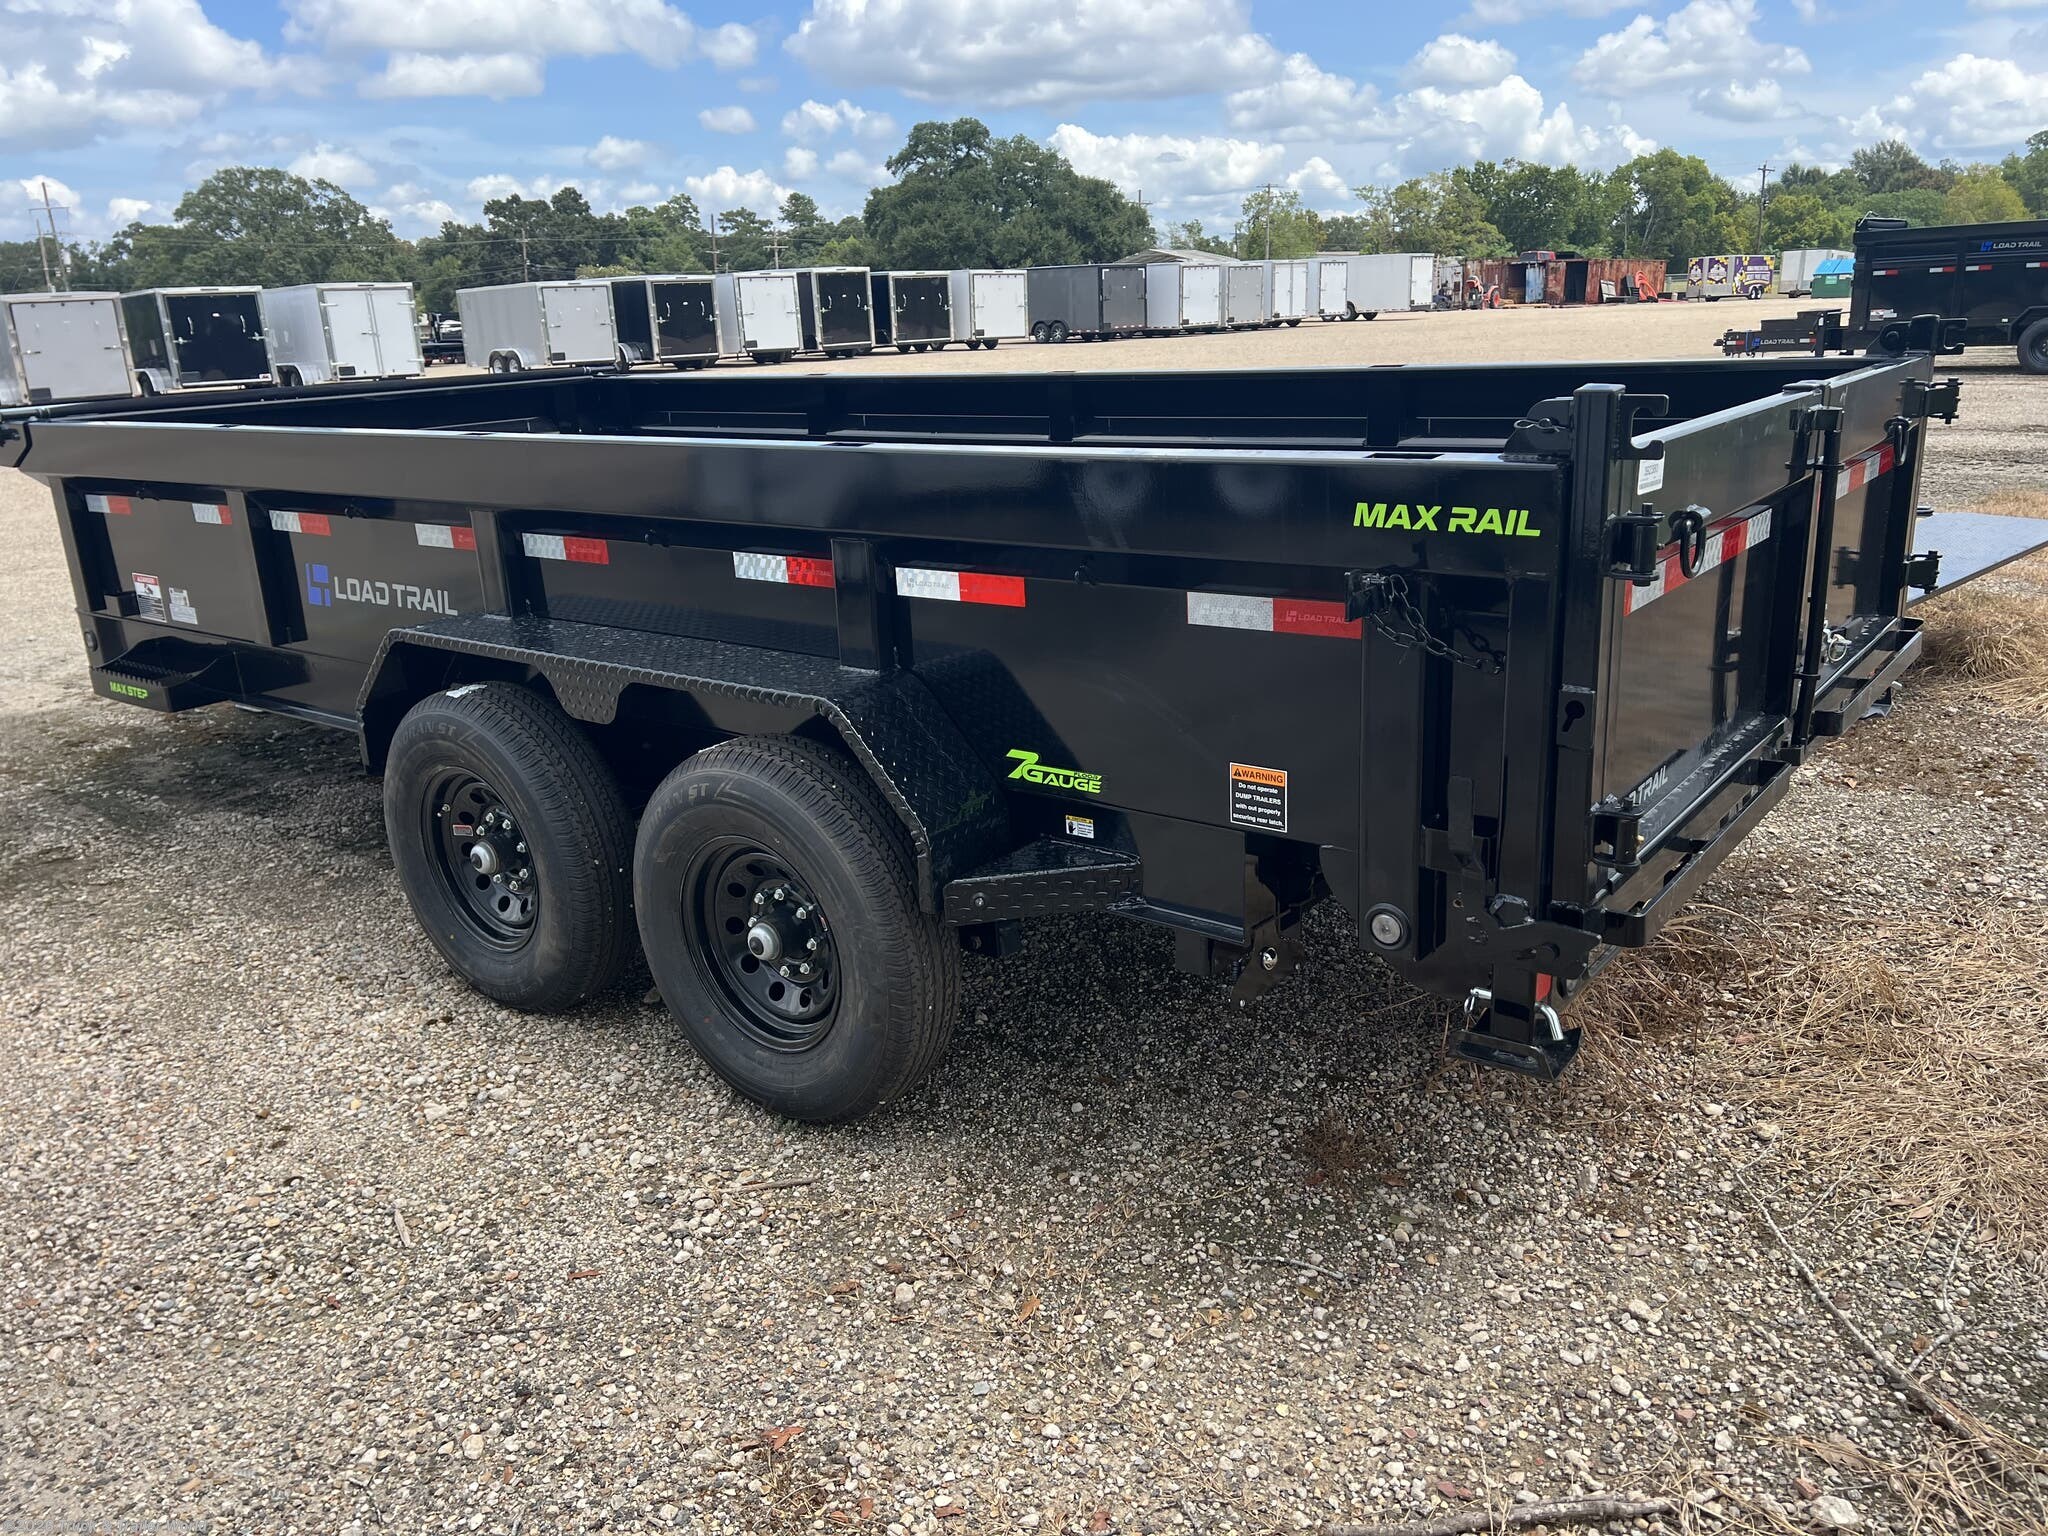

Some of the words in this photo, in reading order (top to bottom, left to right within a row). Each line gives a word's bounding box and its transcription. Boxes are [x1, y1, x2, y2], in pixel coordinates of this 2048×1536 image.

[1353, 502, 1442, 532] MAX
[1447, 506, 1541, 537] RAIL
[334, 576, 389, 606] LOAD
[392, 583, 459, 617] TRAIL
[127, 685, 148, 699] STEP
[1006, 749, 1040, 779] 7
[1022, 763, 1102, 794] GAUGE
[1241, 770, 1283, 783] WARNING
[1638, 765, 1668, 804] TRAIL
[1253, 795, 1281, 805] TRAILERS
[1257, 786, 1278, 794] operate
[1258, 807, 1280, 816] properly
